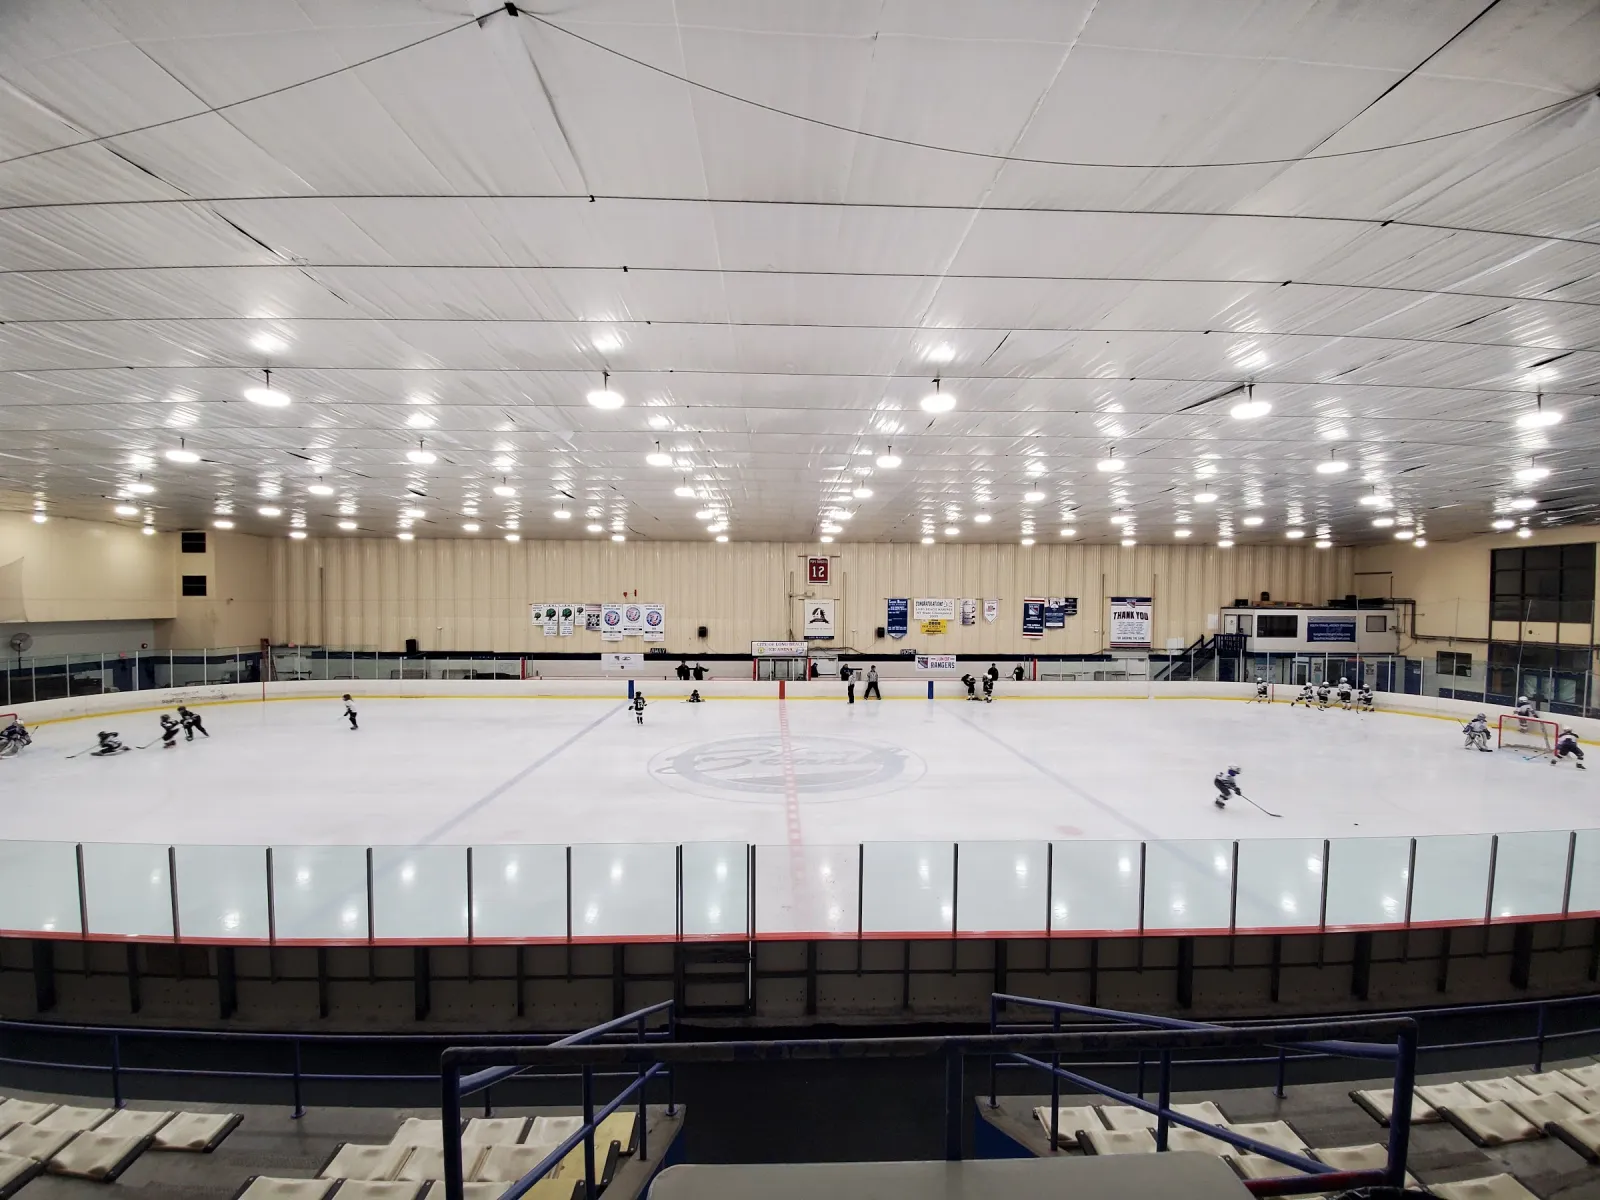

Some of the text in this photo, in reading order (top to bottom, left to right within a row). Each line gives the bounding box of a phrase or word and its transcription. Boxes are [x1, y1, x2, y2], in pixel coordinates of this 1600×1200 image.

[812, 566, 825, 578] 12
[1113, 611, 1149, 621] THANK YOU
[930, 661, 955, 669] RANGERS
